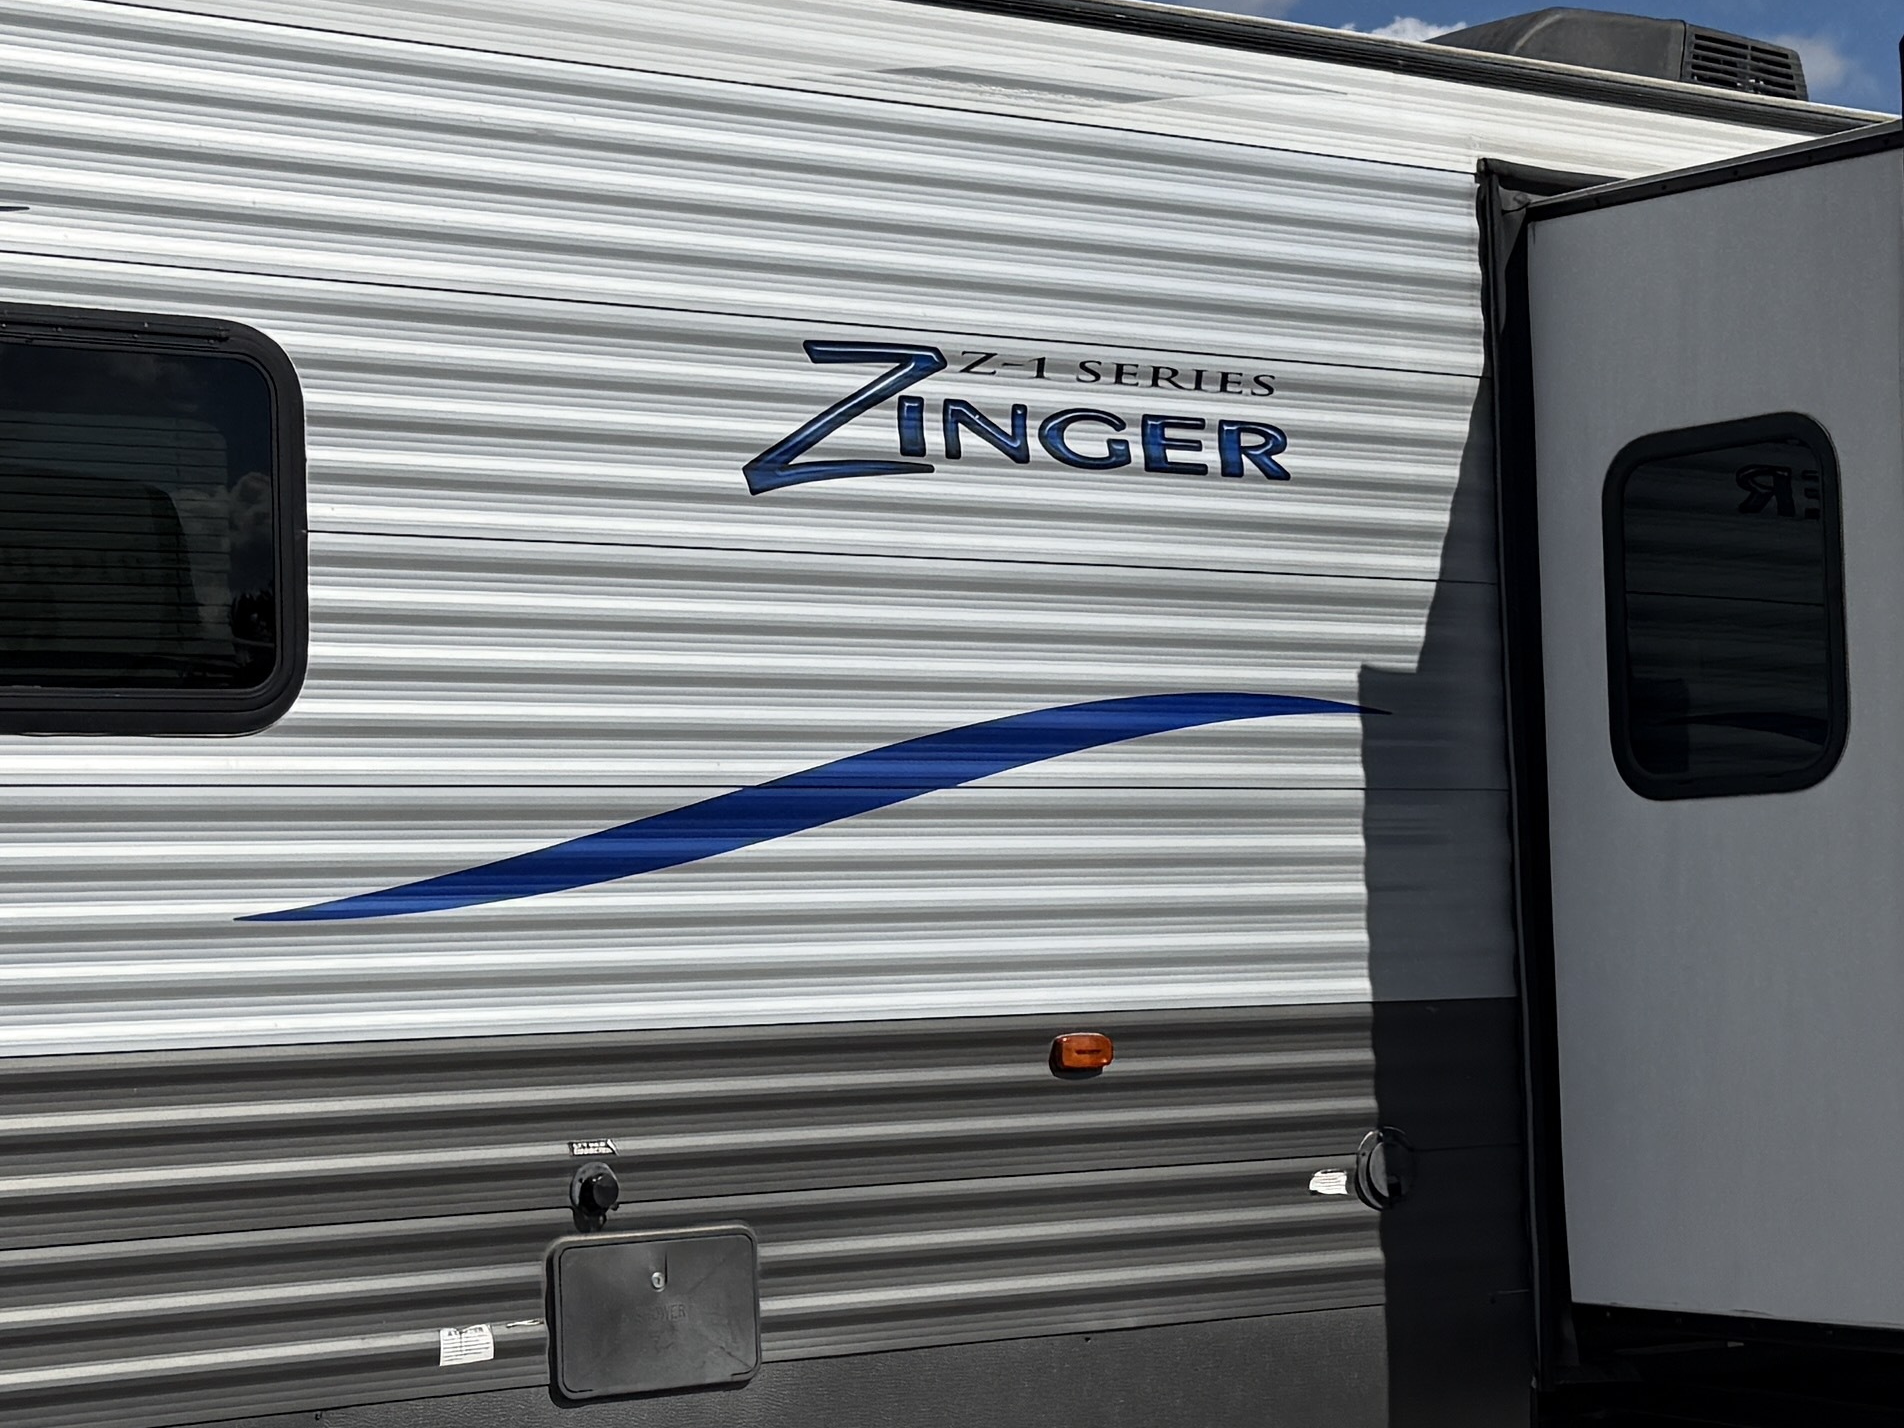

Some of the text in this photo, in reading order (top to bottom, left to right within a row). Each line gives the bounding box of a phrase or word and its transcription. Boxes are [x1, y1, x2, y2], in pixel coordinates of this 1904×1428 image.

[742, 339, 1291, 496] ZINGER
[959, 350, 1276, 397] Z-1 SERIES
